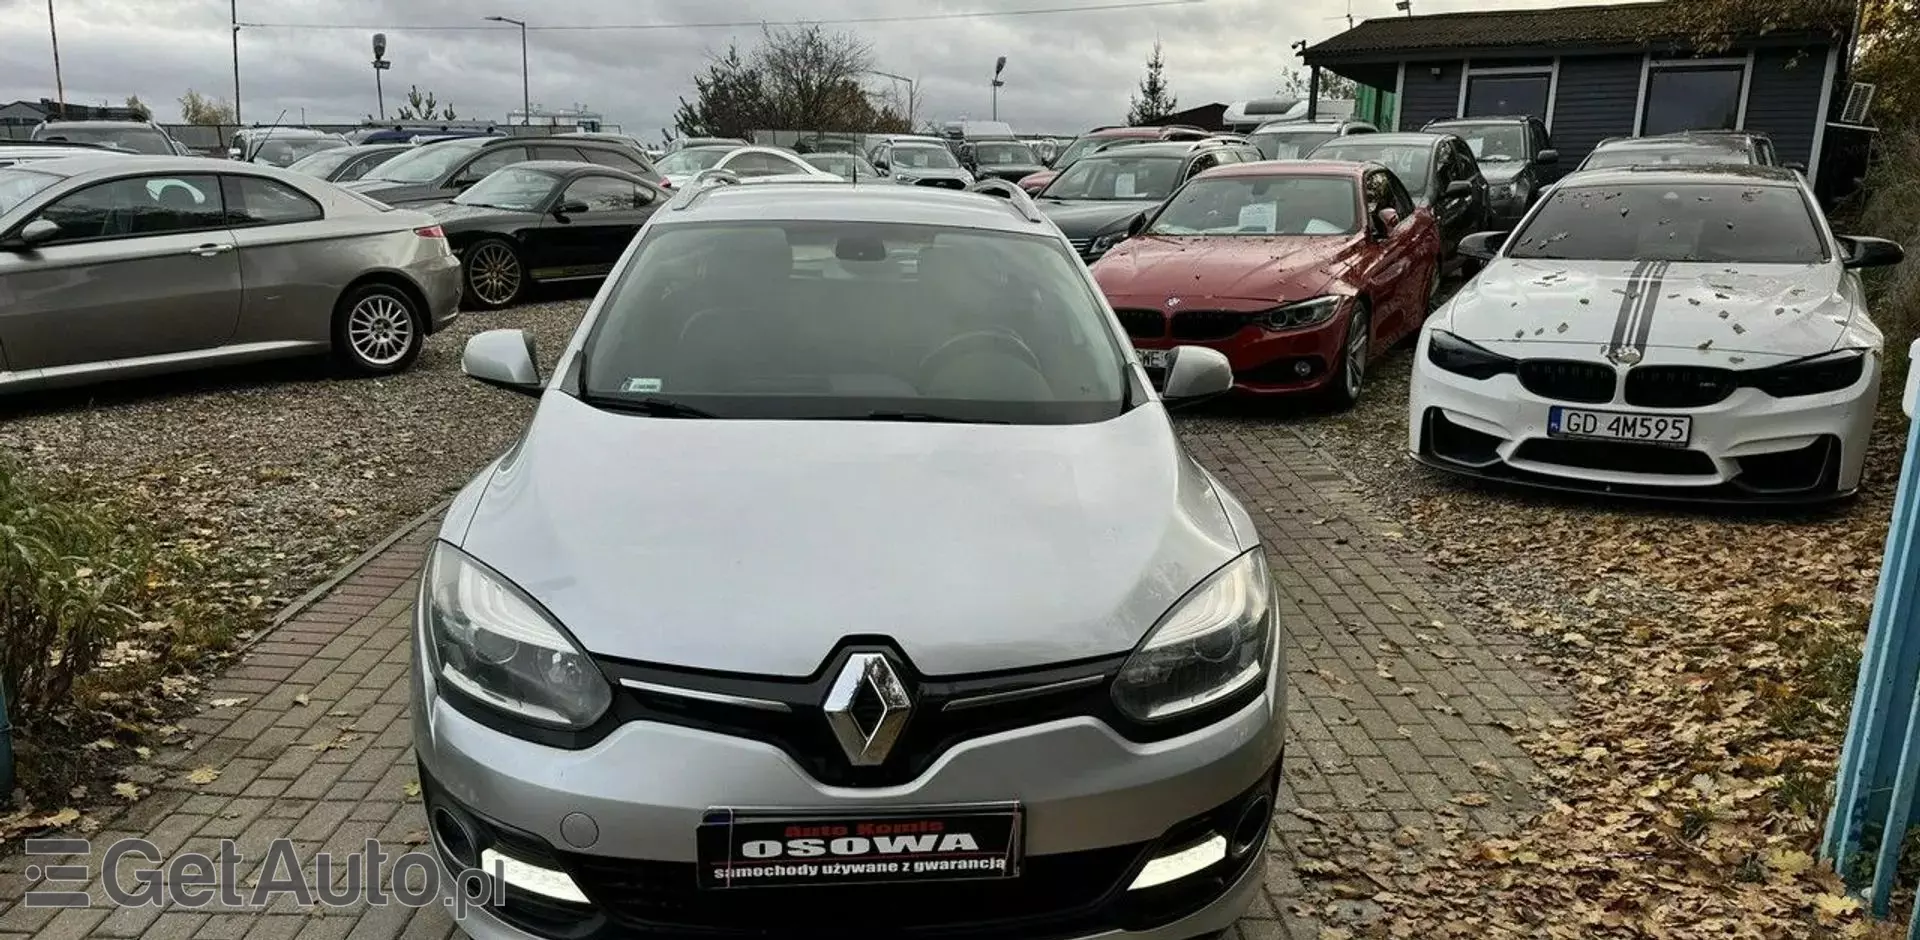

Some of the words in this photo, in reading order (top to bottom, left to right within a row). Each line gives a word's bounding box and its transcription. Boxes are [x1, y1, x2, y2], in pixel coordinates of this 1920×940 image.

[1567, 412, 1598, 434] GD
[1607, 415, 1684, 440] 4M595
[785, 825, 848, 838] Auto
[856, 821, 944, 836] Komis
[742, 833, 979, 858] OSOWA
[714, 863, 818, 879] samochody
[822, 861, 898, 875] używane
[902, 862, 910, 872] z
[914, 857, 1006, 873] gwarancją
